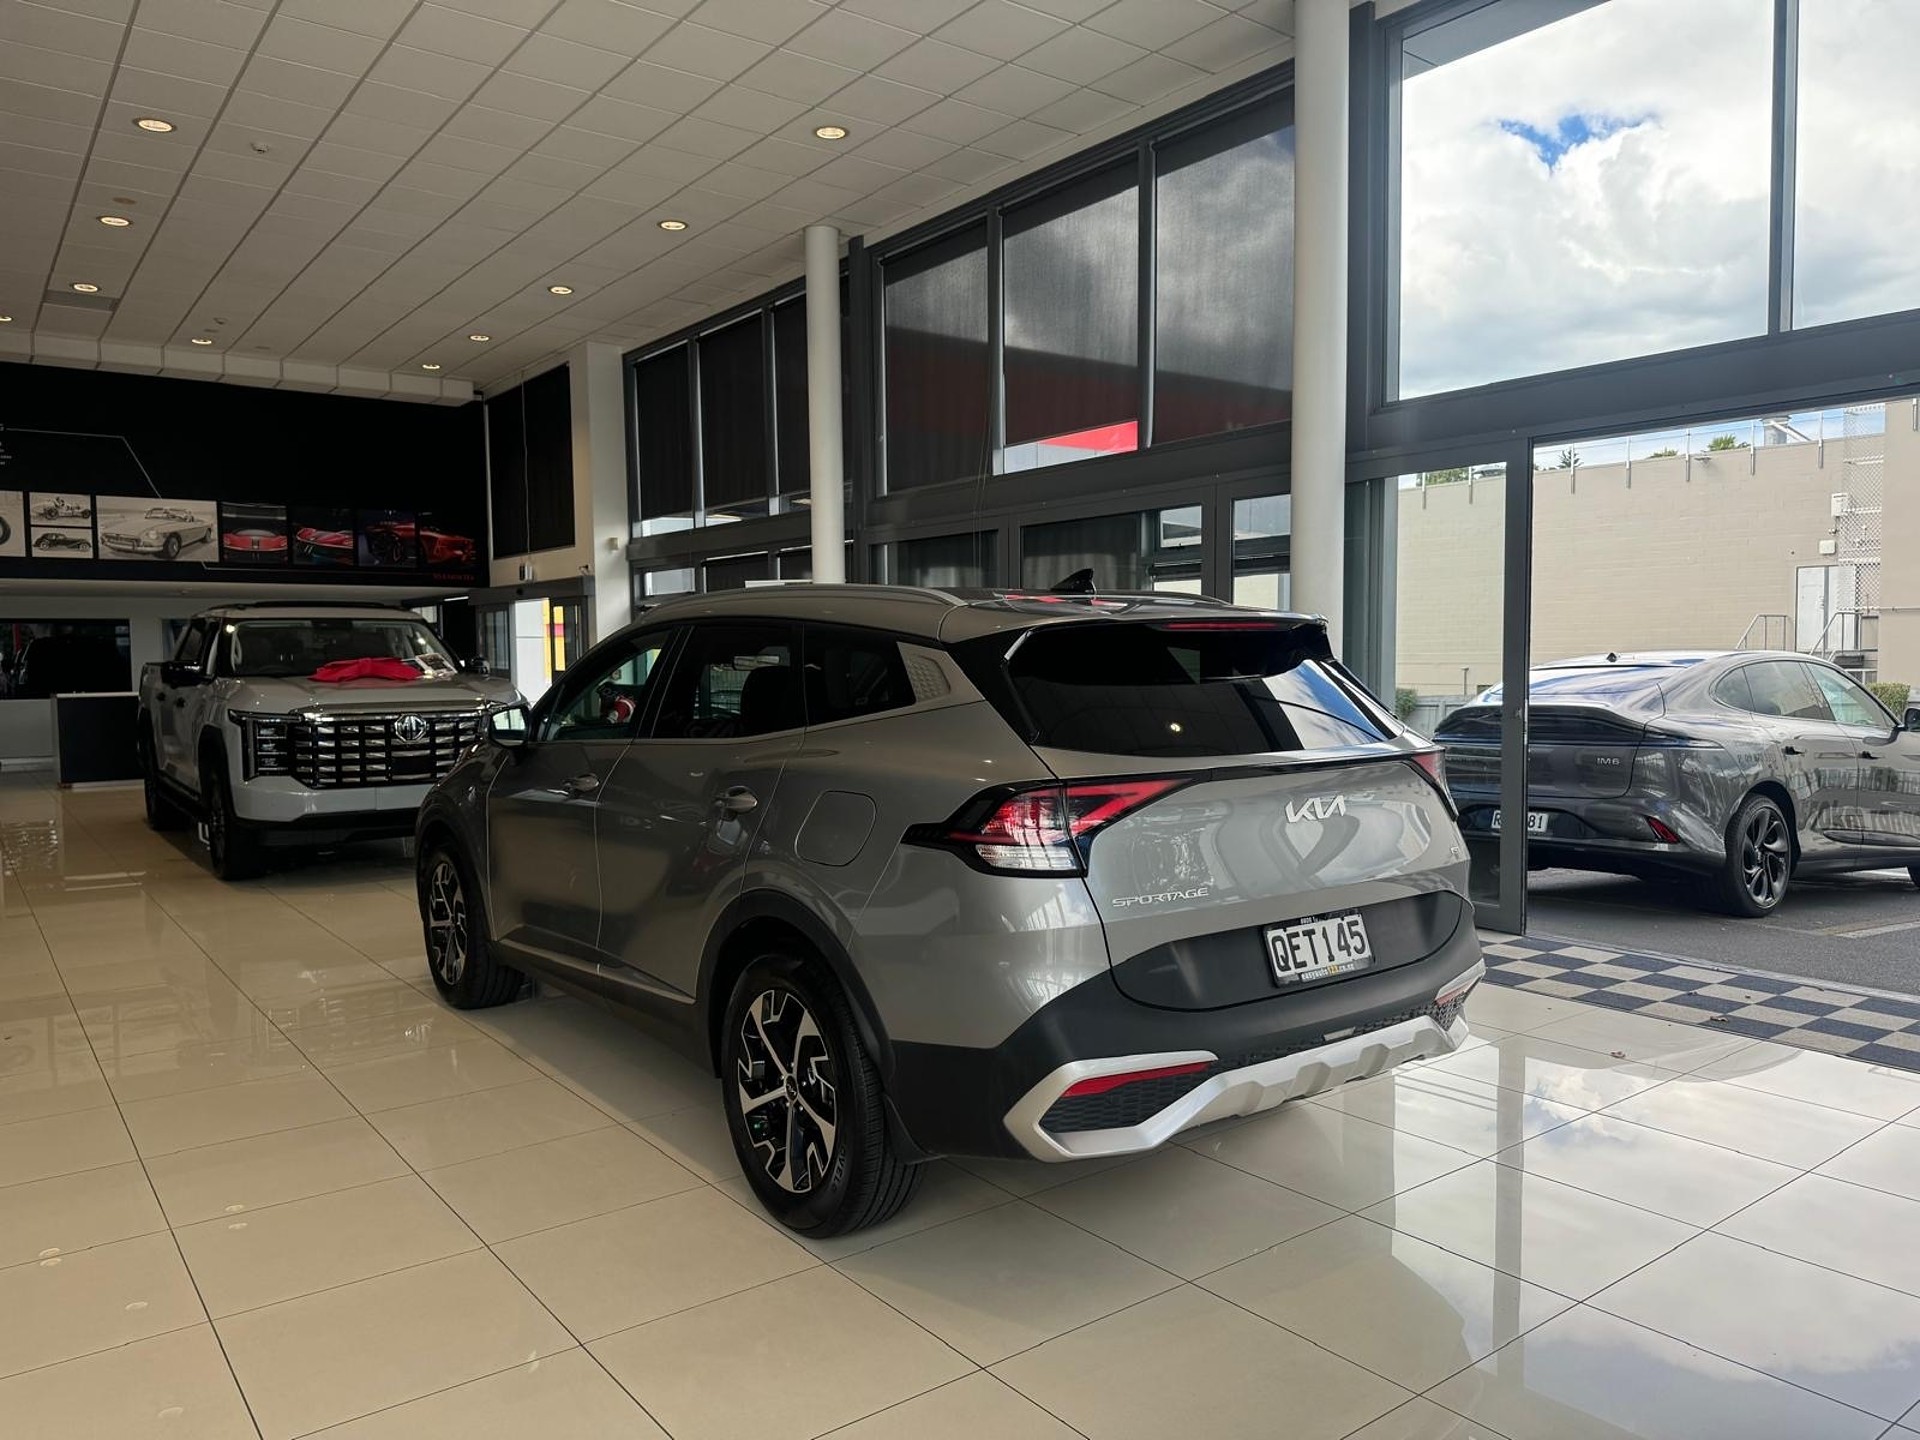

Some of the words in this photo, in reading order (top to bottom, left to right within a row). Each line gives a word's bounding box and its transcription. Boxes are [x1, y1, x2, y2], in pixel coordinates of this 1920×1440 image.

[396, 714, 425, 741] MG
[1596, 757, 1620, 766] IM6
[1285, 794, 1346, 823] KIA
[1493, 811, 1543, 829] R81
[1112, 887, 1210, 908] SPORTAGE
[1271, 919, 1367, 973] QET145
